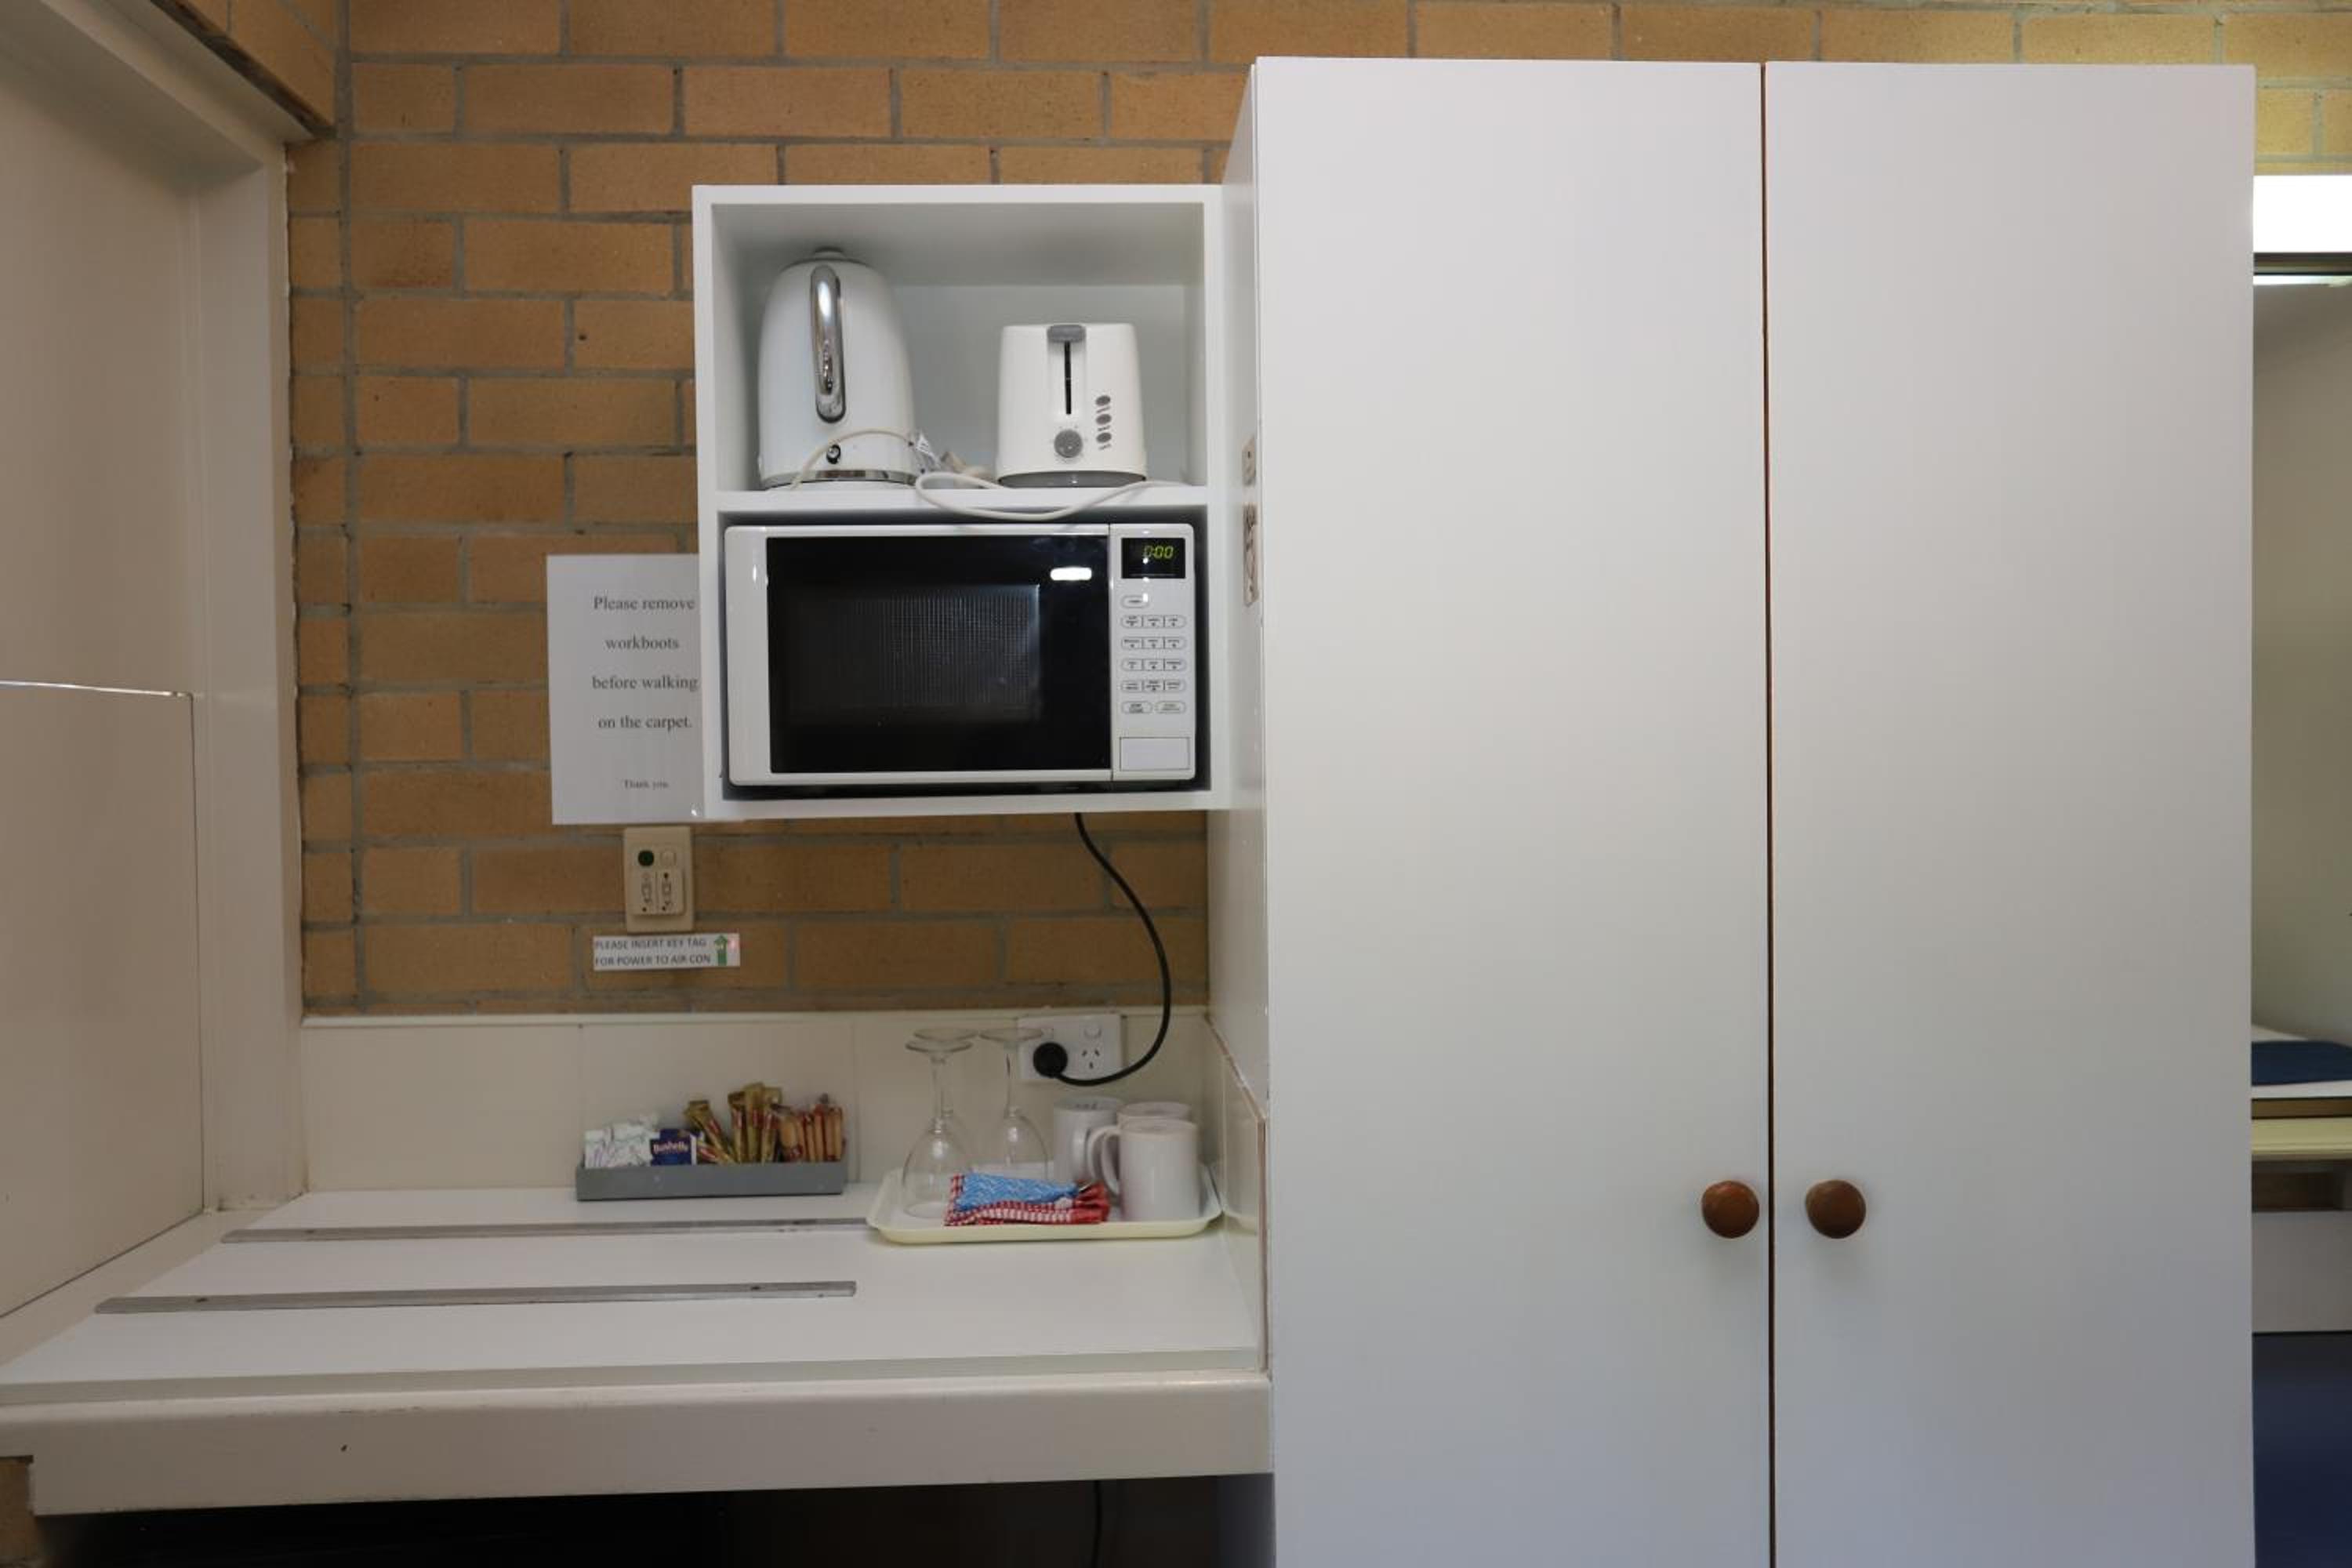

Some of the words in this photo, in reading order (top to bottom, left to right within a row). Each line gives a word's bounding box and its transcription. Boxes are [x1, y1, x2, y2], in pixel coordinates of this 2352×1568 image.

[1143, 545, 1174, 559] 0:00
[593, 596, 637, 610] Please
[642, 599, 695, 610] remove
[605, 635, 680, 649] workboots
[592, 675, 637, 689] before
[642, 674, 699, 692] walking
[598, 717, 615, 728] on
[620, 715, 641, 728] the
[645, 716, 692, 733] carpet.
[625, 779, 649, 789] Thank
[595, 940, 628, 950] PLEASE
[631, 939, 662, 949] INSERT
[667, 938, 684, 948] KEY
[688, 937, 707, 947] TAG
[595, 956, 614, 967] FOR
[618, 956, 653, 966] POWER
[656, 955, 669, 965] TO
[670, 954, 686, 964] AIR
[689, 953, 711, 964] CON
